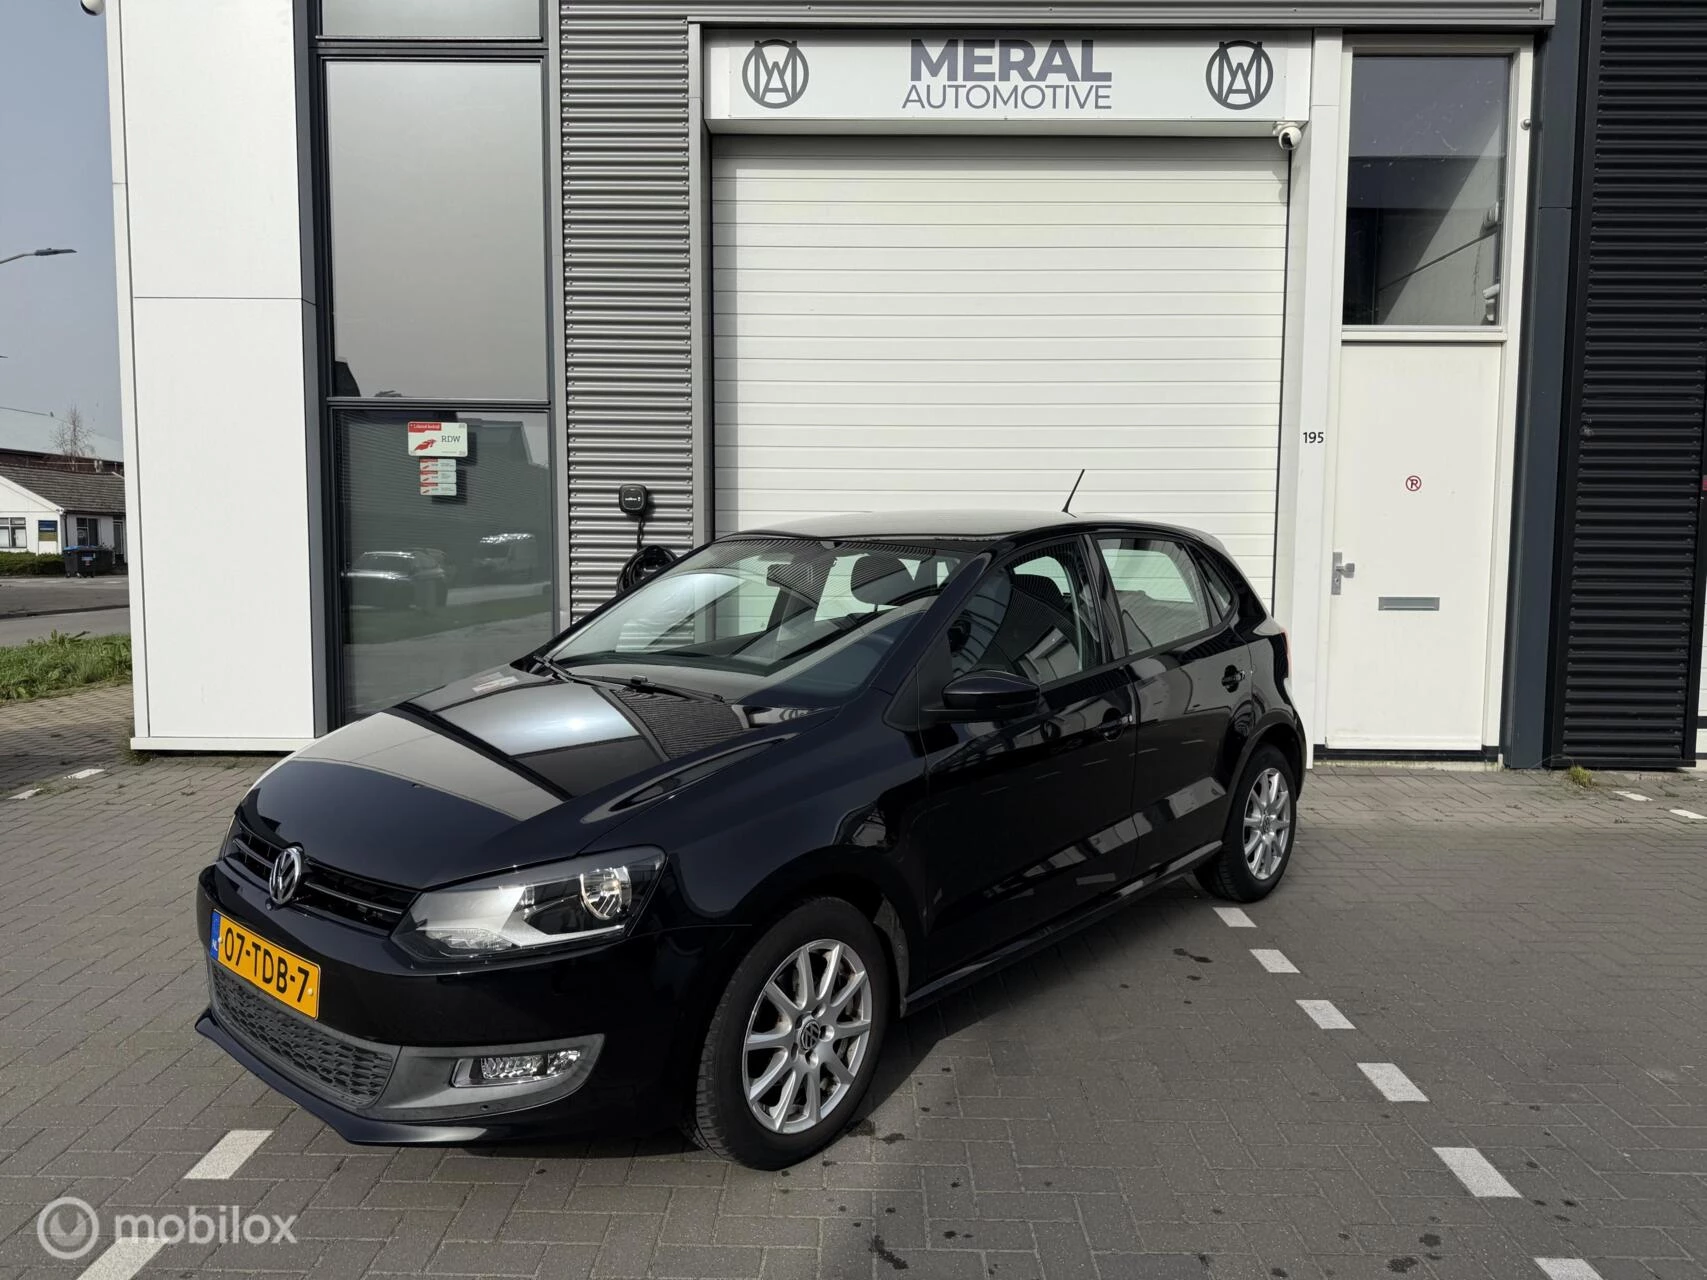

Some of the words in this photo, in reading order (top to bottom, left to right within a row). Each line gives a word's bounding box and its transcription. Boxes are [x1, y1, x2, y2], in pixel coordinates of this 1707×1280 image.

[910, 39, 1112, 82] MERAL
[902, 84, 1112, 110] AUTOMOTIVE
[441, 435, 461, 443] RDW
[1303, 431, 1324, 444] 195
[224, 927, 310, 1003] 07-TDB-7
